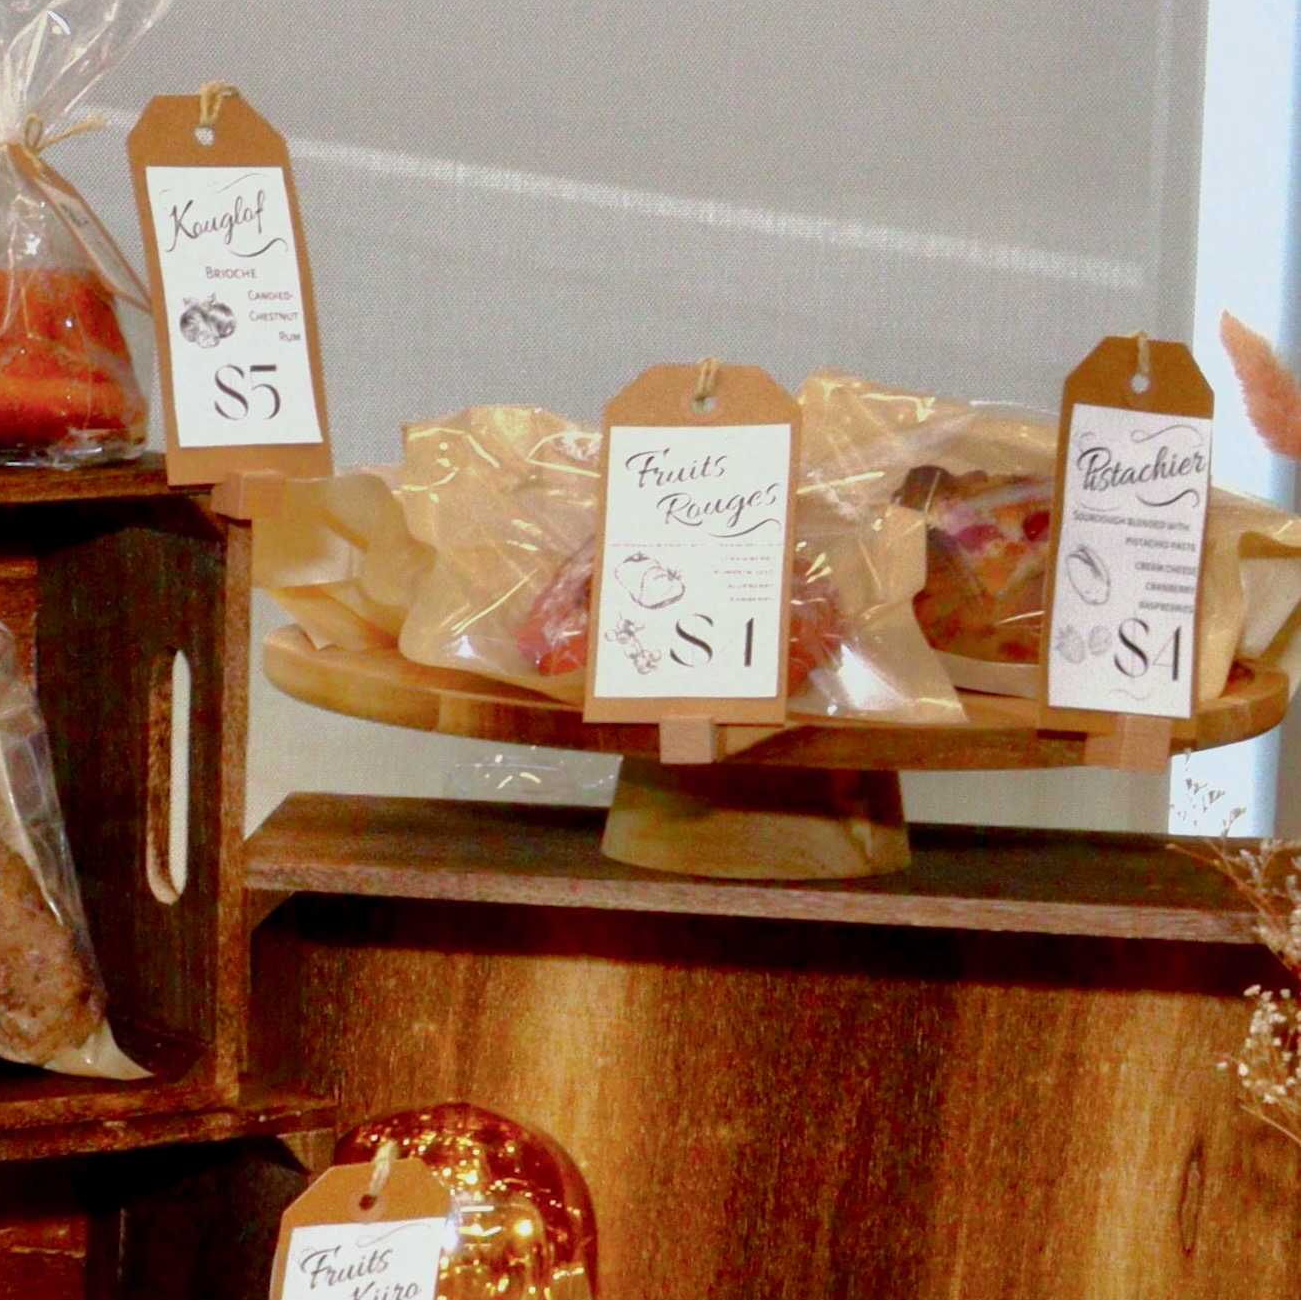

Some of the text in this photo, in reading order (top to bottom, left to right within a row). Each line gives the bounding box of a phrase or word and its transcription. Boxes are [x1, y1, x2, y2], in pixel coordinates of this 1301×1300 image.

[625, 448, 728, 488] Fruits
[1077, 446, 1206, 492] Pistachier
[656, 483, 779, 527] Rouges
[1113, 615, 1183, 682] $4
[299, 1245, 394, 1289] Fruits
